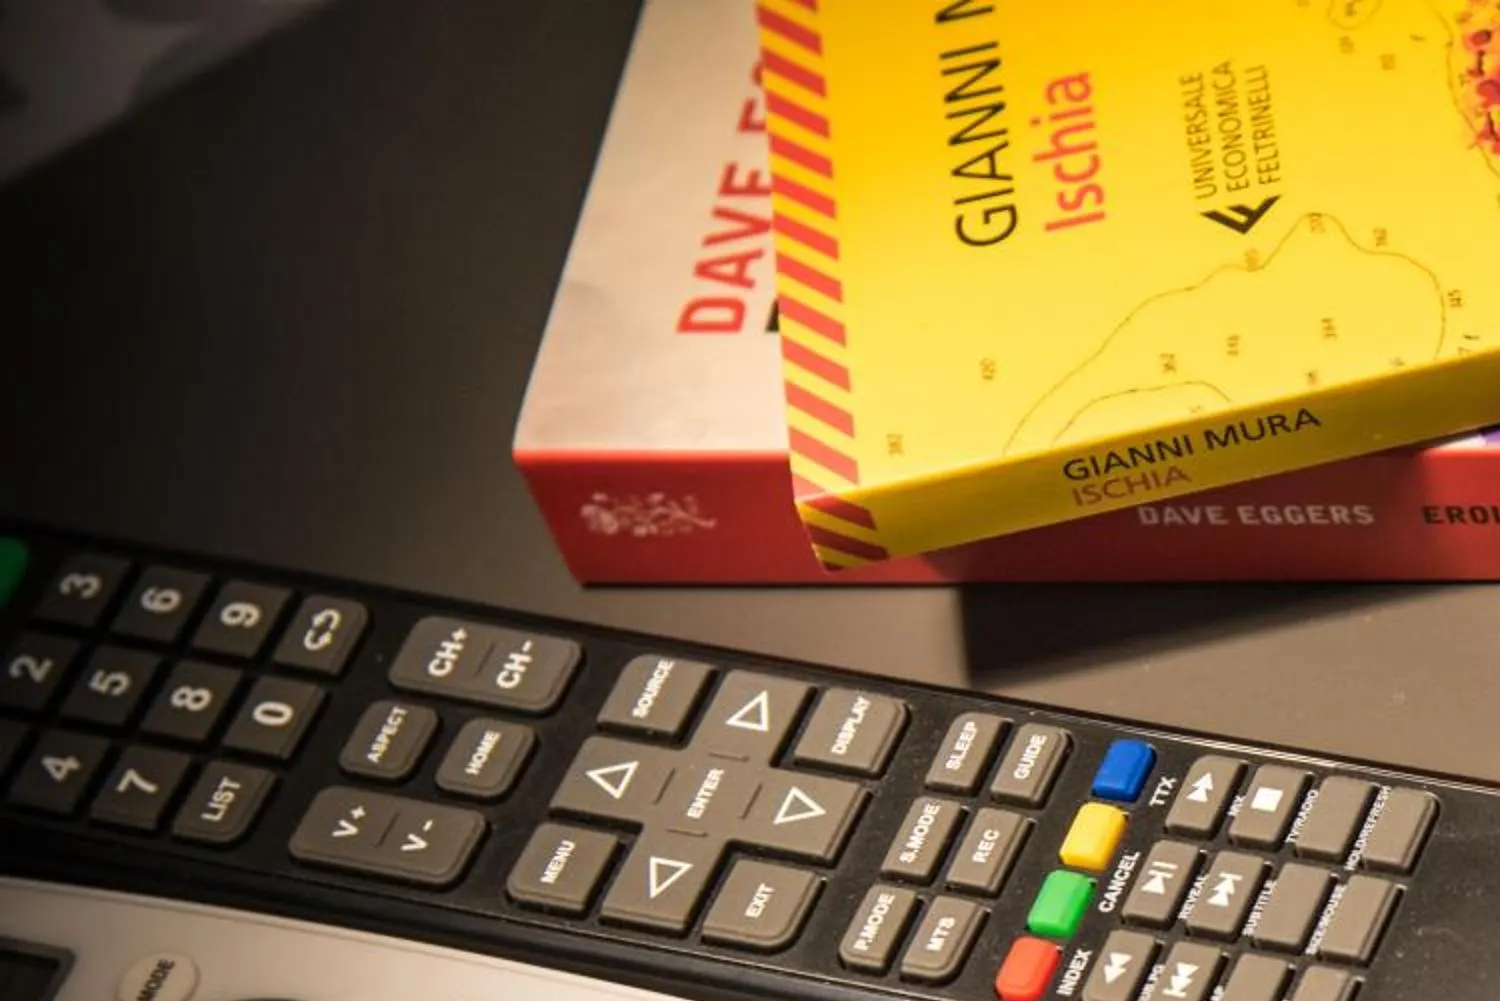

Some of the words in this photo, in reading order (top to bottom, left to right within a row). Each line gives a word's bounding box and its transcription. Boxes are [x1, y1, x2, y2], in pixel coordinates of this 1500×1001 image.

[938, 41, 1018, 248] GIANNI
[1179, 71, 1219, 200] UNIVERSALE
[1211, 59, 1251, 194] ECONOMICA
[1244, 64, 1282, 186] FELTRINELLI
[1029, 71, 1106, 232] Ischia
[674, 161, 774, 335] DAVE
[1062, 434, 1194, 482] GIANNI
[1203, 407, 1322, 451] MURA
[1071, 464, 1194, 508] ISCHIA
[1136, 504, 1230, 527] DAVE
[1237, 504, 1377, 527] EGGERS
[58, 571, 102, 600] 3
[140, 588, 182, 614] 6
[219, 601, 262, 629] 9
[9, 654, 54, 684] 2
[427, 626, 470, 678] CH+
[495, 638, 536, 690] CH-
[89, 668, 130, 696] 5
[171, 685, 214, 712] 8
[631, 658, 674, 719] SOURCE
[365, 705, 408, 764] ASPECT
[830, 695, 873, 755] DISPLAY
[944, 719, 980, 771] SLEEP
[41, 753, 83, 783] 4
[463, 729, 503, 777] HOME
[1013, 733, 1050, 780] GUIDE
[116, 768, 161, 796] 7
[201, 776, 242, 823] LIST
[686, 766, 726, 820] ENTER
[1149, 775, 1178, 808] TTX
[540, 839, 576, 885] MENU
[971, 828, 1001, 864] REC
[745, 882, 777, 919] EXIT
[1097, 850, 1141, 914] CANCEL
[1055, 948, 1093, 997] INDEX
